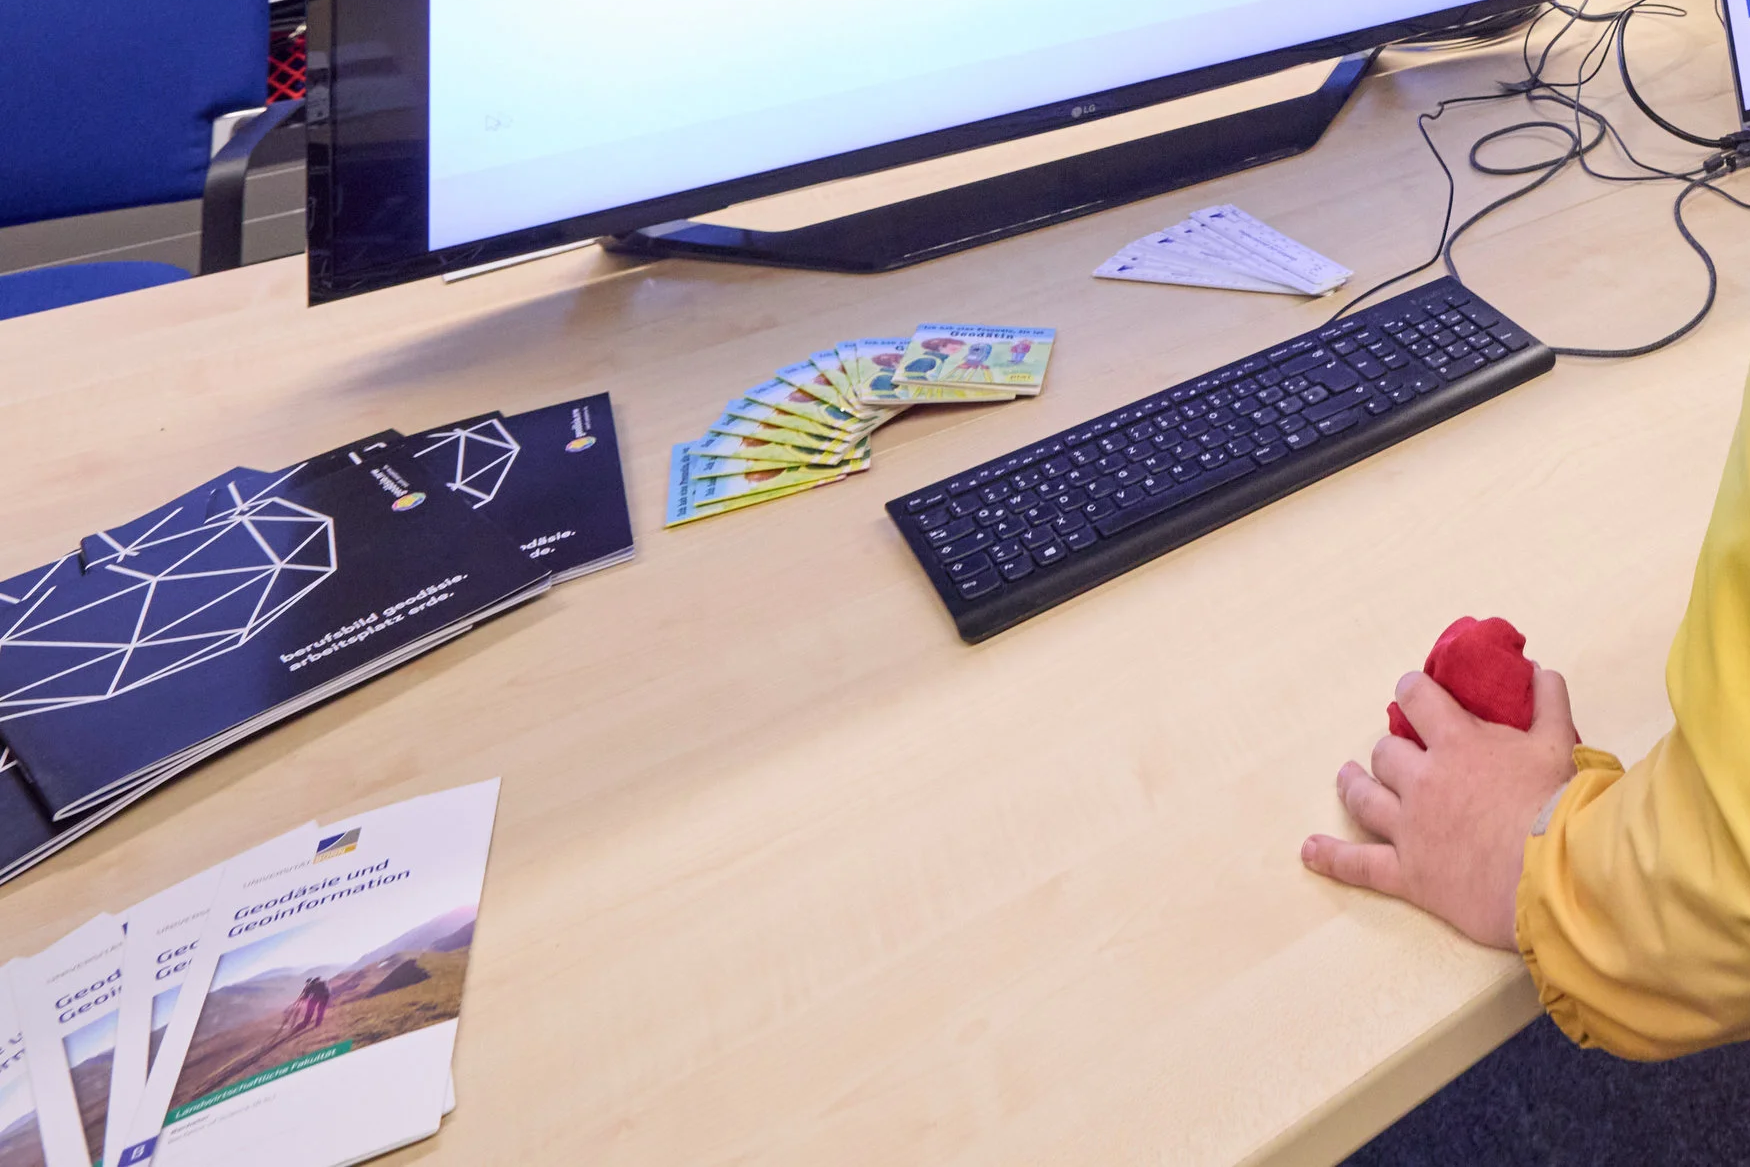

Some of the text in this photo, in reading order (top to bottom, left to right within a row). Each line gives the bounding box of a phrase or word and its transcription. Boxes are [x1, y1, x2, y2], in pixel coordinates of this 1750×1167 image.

[280, 573, 468, 663] berufsbild geodäsie.
[289, 591, 455, 672] arbeitsplatz erde.
[228, 869, 410, 938] Geoinformation
[234, 857, 390, 921] Geodäsie und
[55, 968, 122, 1010] Geod
[174, 1066, 290, 1120] Landwirtschaftliche
[290, 1047, 337, 1073] Fakultät
